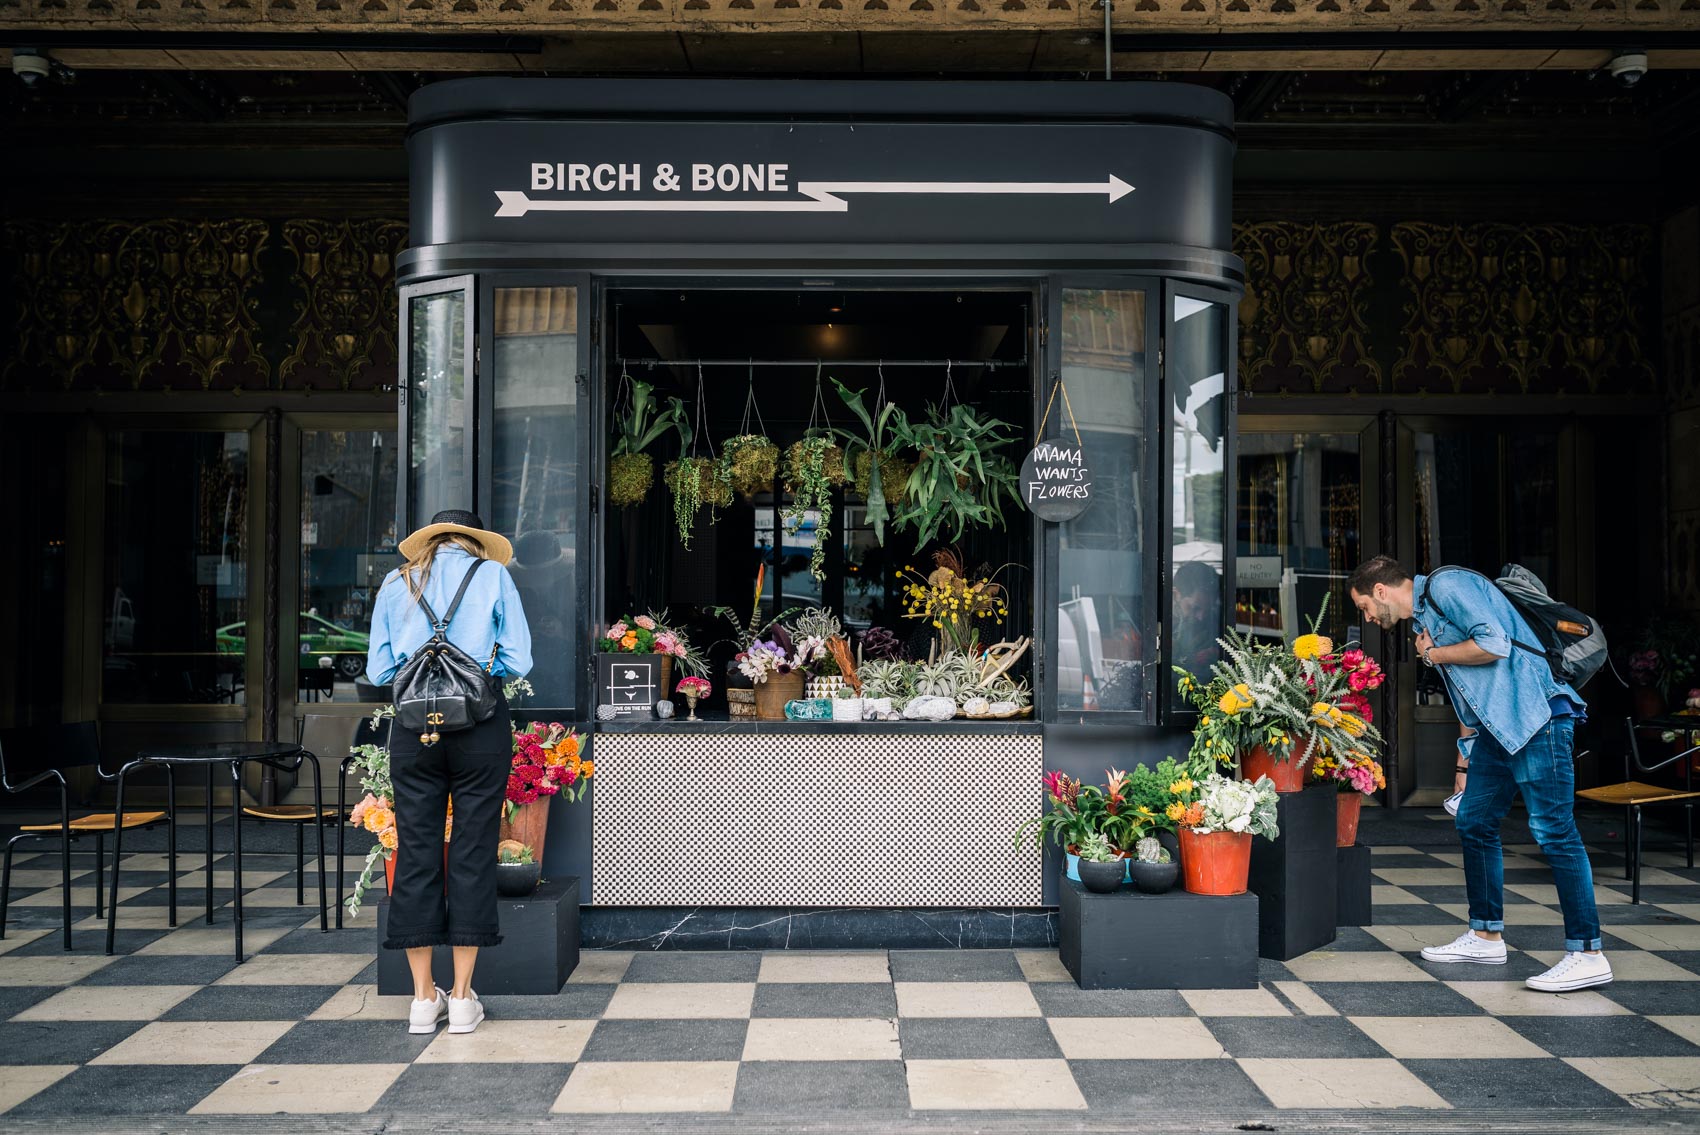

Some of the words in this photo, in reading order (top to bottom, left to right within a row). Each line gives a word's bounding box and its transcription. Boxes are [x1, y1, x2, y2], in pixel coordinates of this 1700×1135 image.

[531, 163, 641, 191] BIRCH
[652, 163, 681, 192] &
[692, 163, 789, 192] BONE
[1033, 446, 1082, 467] MAMA
[1035, 466, 1088, 481] WANTS
[1028, 481, 1091, 504] FLOWERS
